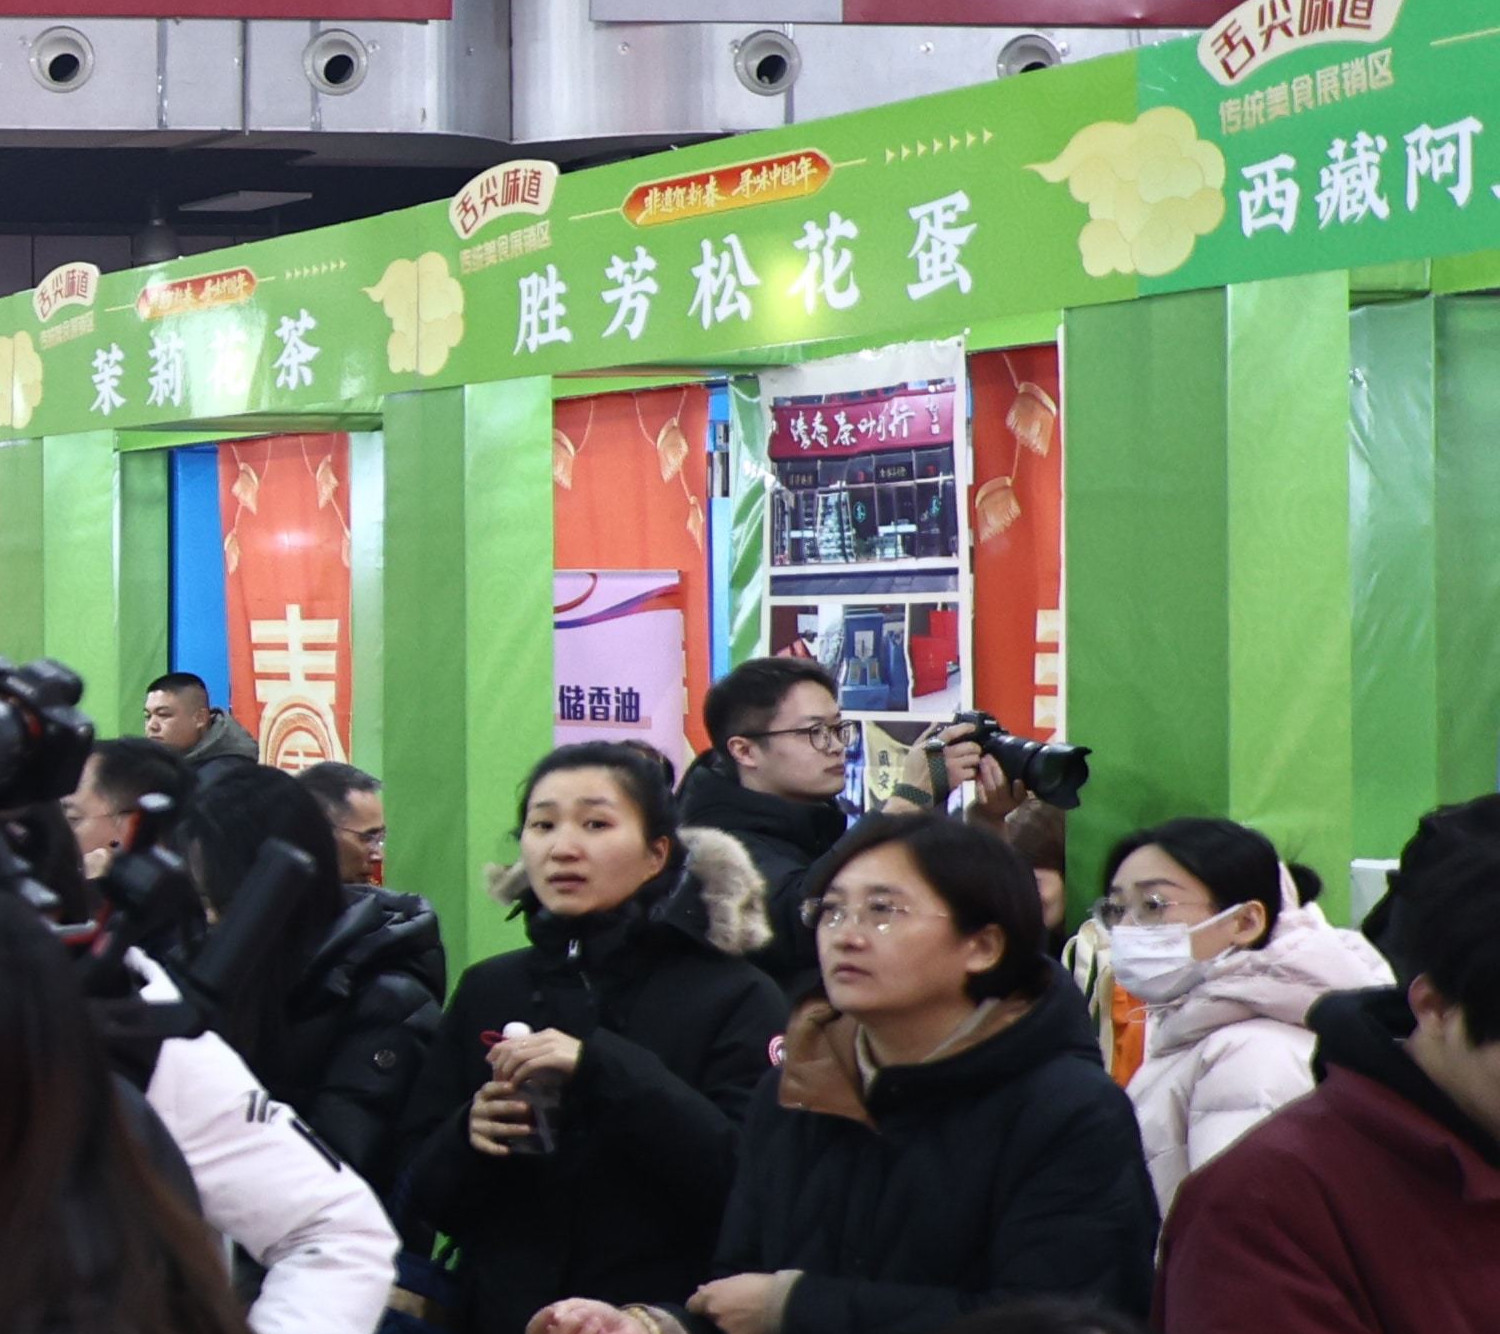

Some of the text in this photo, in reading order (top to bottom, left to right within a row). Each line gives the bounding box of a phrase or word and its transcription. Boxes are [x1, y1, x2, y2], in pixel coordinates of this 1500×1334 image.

[1219, 47, 1394, 136] 传统美食展销区
[457, 167, 541, 239] 舌尖味道
[1239, 116, 1500, 238] 西藏阿
[513, 190, 978, 355] 胜芳松花蛋
[90, 309, 320, 416] 茉莉花茶
[559, 684, 641, 724] 储香油
